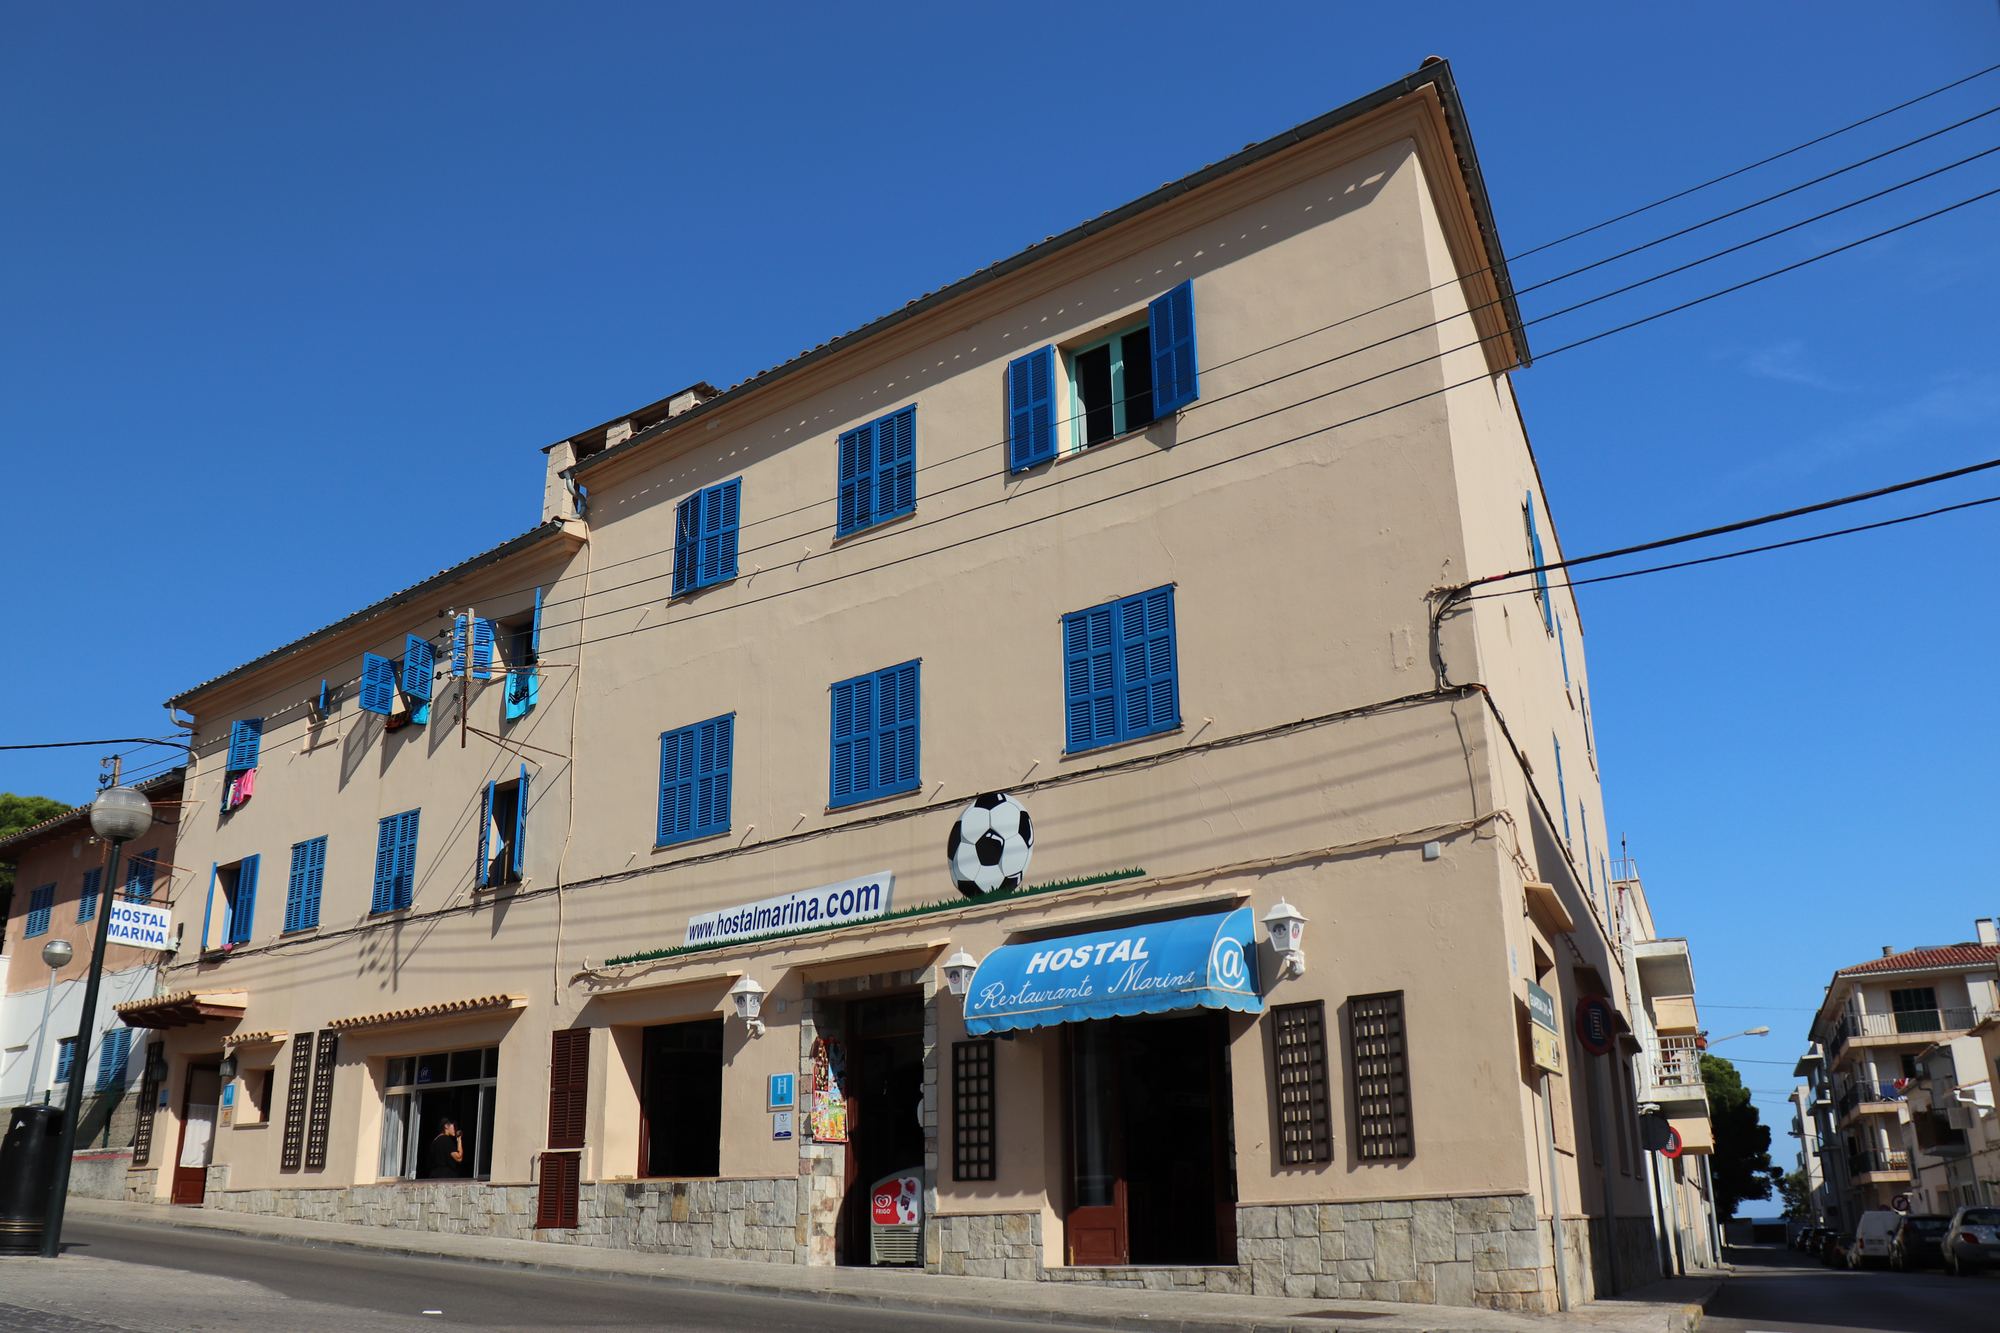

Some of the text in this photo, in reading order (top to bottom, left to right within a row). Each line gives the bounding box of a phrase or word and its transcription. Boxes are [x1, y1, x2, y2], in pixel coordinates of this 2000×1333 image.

[110, 907, 167, 929] HOSTAL
[689, 883, 880, 941] www.hostalmarina.com
[108, 923, 164, 944] MARINA
[1026, 937, 1149, 975] HOSTAL
[974, 960, 1196, 1010] Restaurante Marina
